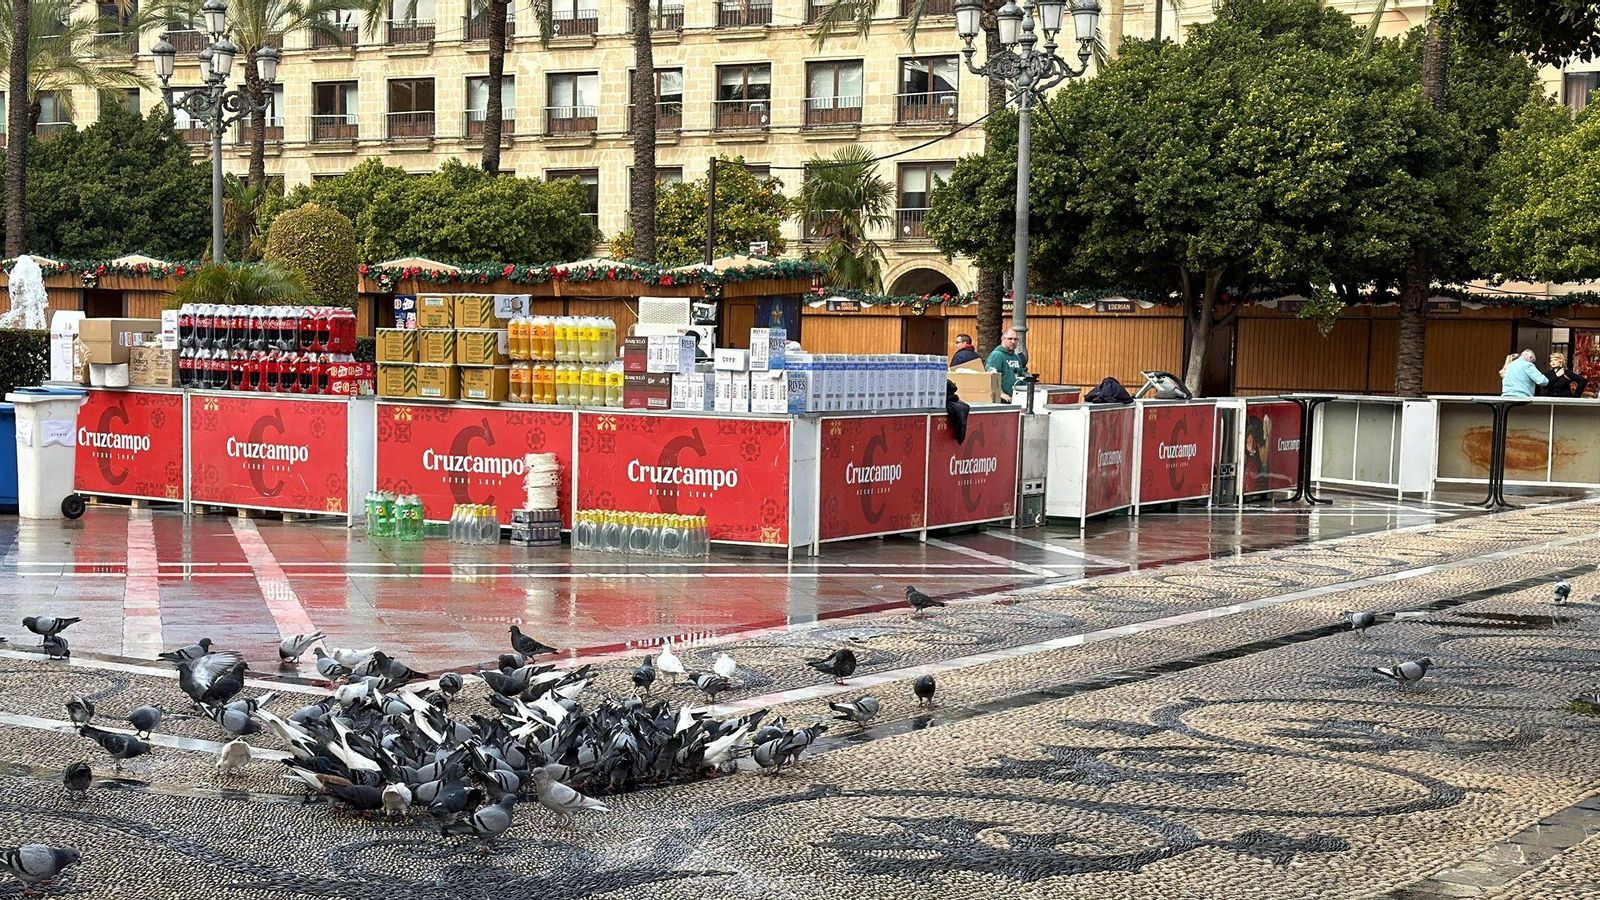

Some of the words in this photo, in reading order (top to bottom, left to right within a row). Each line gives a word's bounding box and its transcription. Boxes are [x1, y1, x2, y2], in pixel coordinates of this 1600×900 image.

[78, 426, 150, 453] Cruzcampo
[226, 436, 309, 464] Cruzcampo
[1158, 442, 1197, 460] Cruzcampo
[1277, 437, 1300, 452] Cruzcamp
[422, 448, 525, 478] Cruzcampo
[627, 459, 738, 490] Cruzcampo
[846, 461, 902, 484] Cruzcampo
[949, 455, 997, 476] Cruzcampo
